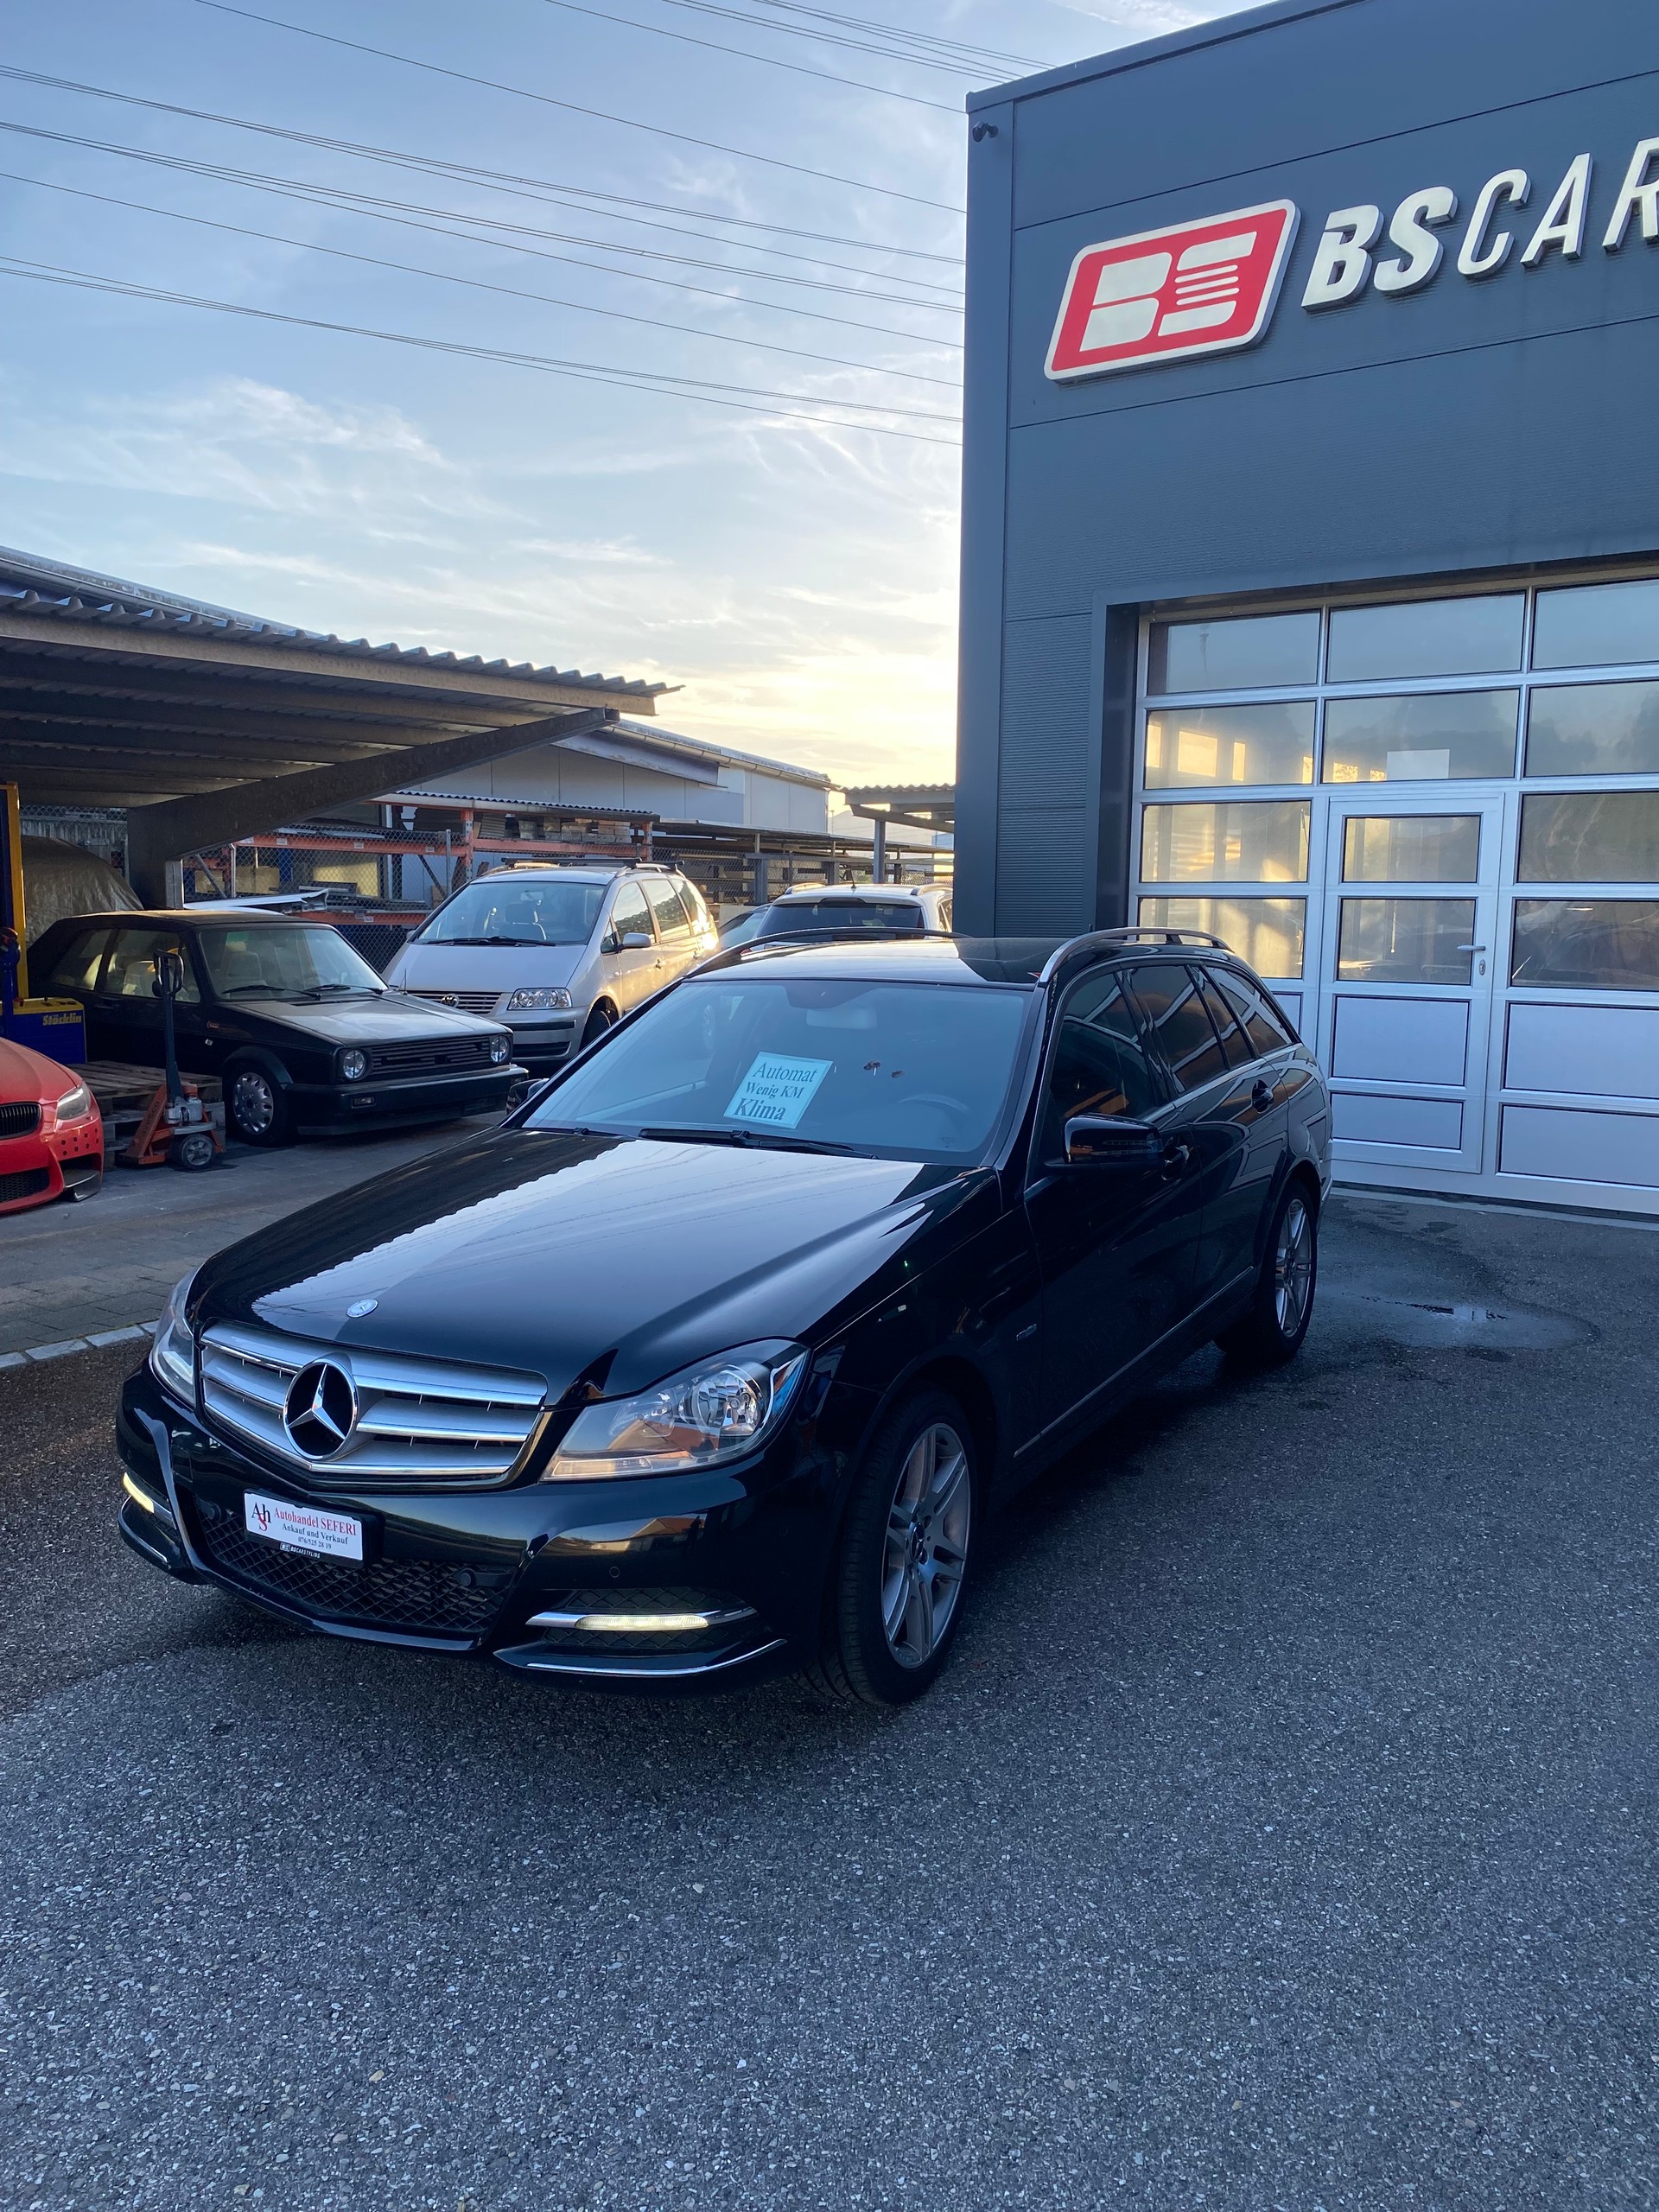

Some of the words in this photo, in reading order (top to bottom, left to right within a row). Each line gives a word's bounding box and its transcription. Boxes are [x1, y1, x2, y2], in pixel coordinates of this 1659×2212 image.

[42, 1013, 82, 1026] Stöcklin
[753, 1062, 817, 1083] Automat
[746, 1082, 779, 1099] Wenig
[780, 1085, 804, 1099] KM
[733, 1097, 786, 1121] Klima
[274, 1507, 320, 1529] Autohandel
[321, 1517, 357, 1536] SEFERI
[282, 1523, 305, 1535] Ankauf
[306, 1530, 320, 1539] und
[321, 1531, 348, 1545] Verkauf
